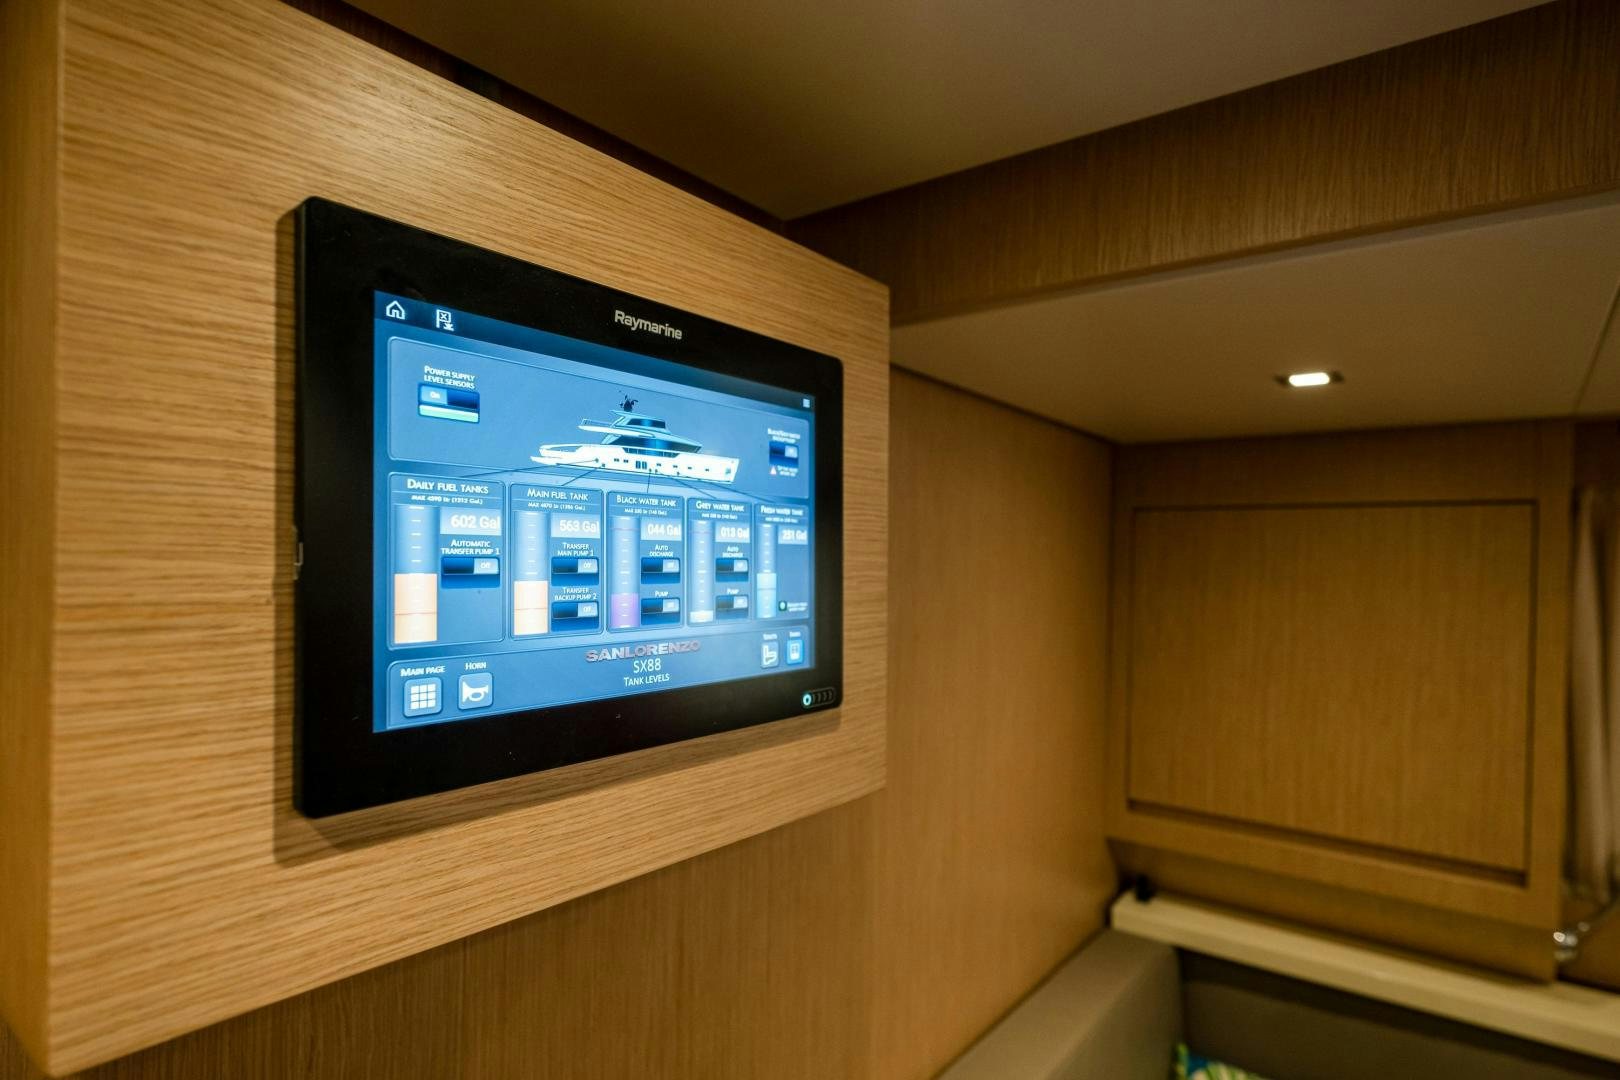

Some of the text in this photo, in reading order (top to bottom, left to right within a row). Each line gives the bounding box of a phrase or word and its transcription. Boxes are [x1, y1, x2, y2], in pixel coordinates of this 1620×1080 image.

[614, 309, 683, 340] Raymarine
[423, 365, 476, 381] POWER SUPPLY
[423, 374, 475, 390] LEVEL SENSORS
[407, 478, 489, 494] DAILY FUEL TANKS
[527, 488, 589, 501] MAIN FUEL TANK
[616, 494, 677, 507] BLACK WATER TANK
[695, 500, 745, 512] GREY WATER TANK
[450, 514, 501, 530] 602 Gal
[559, 519, 600, 533] 563 Gal
[647, 523, 682, 537] 044 Gal
[450, 539, 491, 547] AUTOMATIC
[562, 542, 590, 550] TRANSFER
[441, 547, 474, 555] TRANSFER
[495, 547, 500, 555] 1
[576, 593, 592, 601] PUMP
[592, 592, 597, 600] 2
[585, 639, 702, 663] SANLORENZO
[400, 666, 446, 677] MAIN PAGE
[464, 662, 487, 671] HORN
[633, 658, 662, 674] SX88
[623, 673, 671, 687] TANK LEVELS
